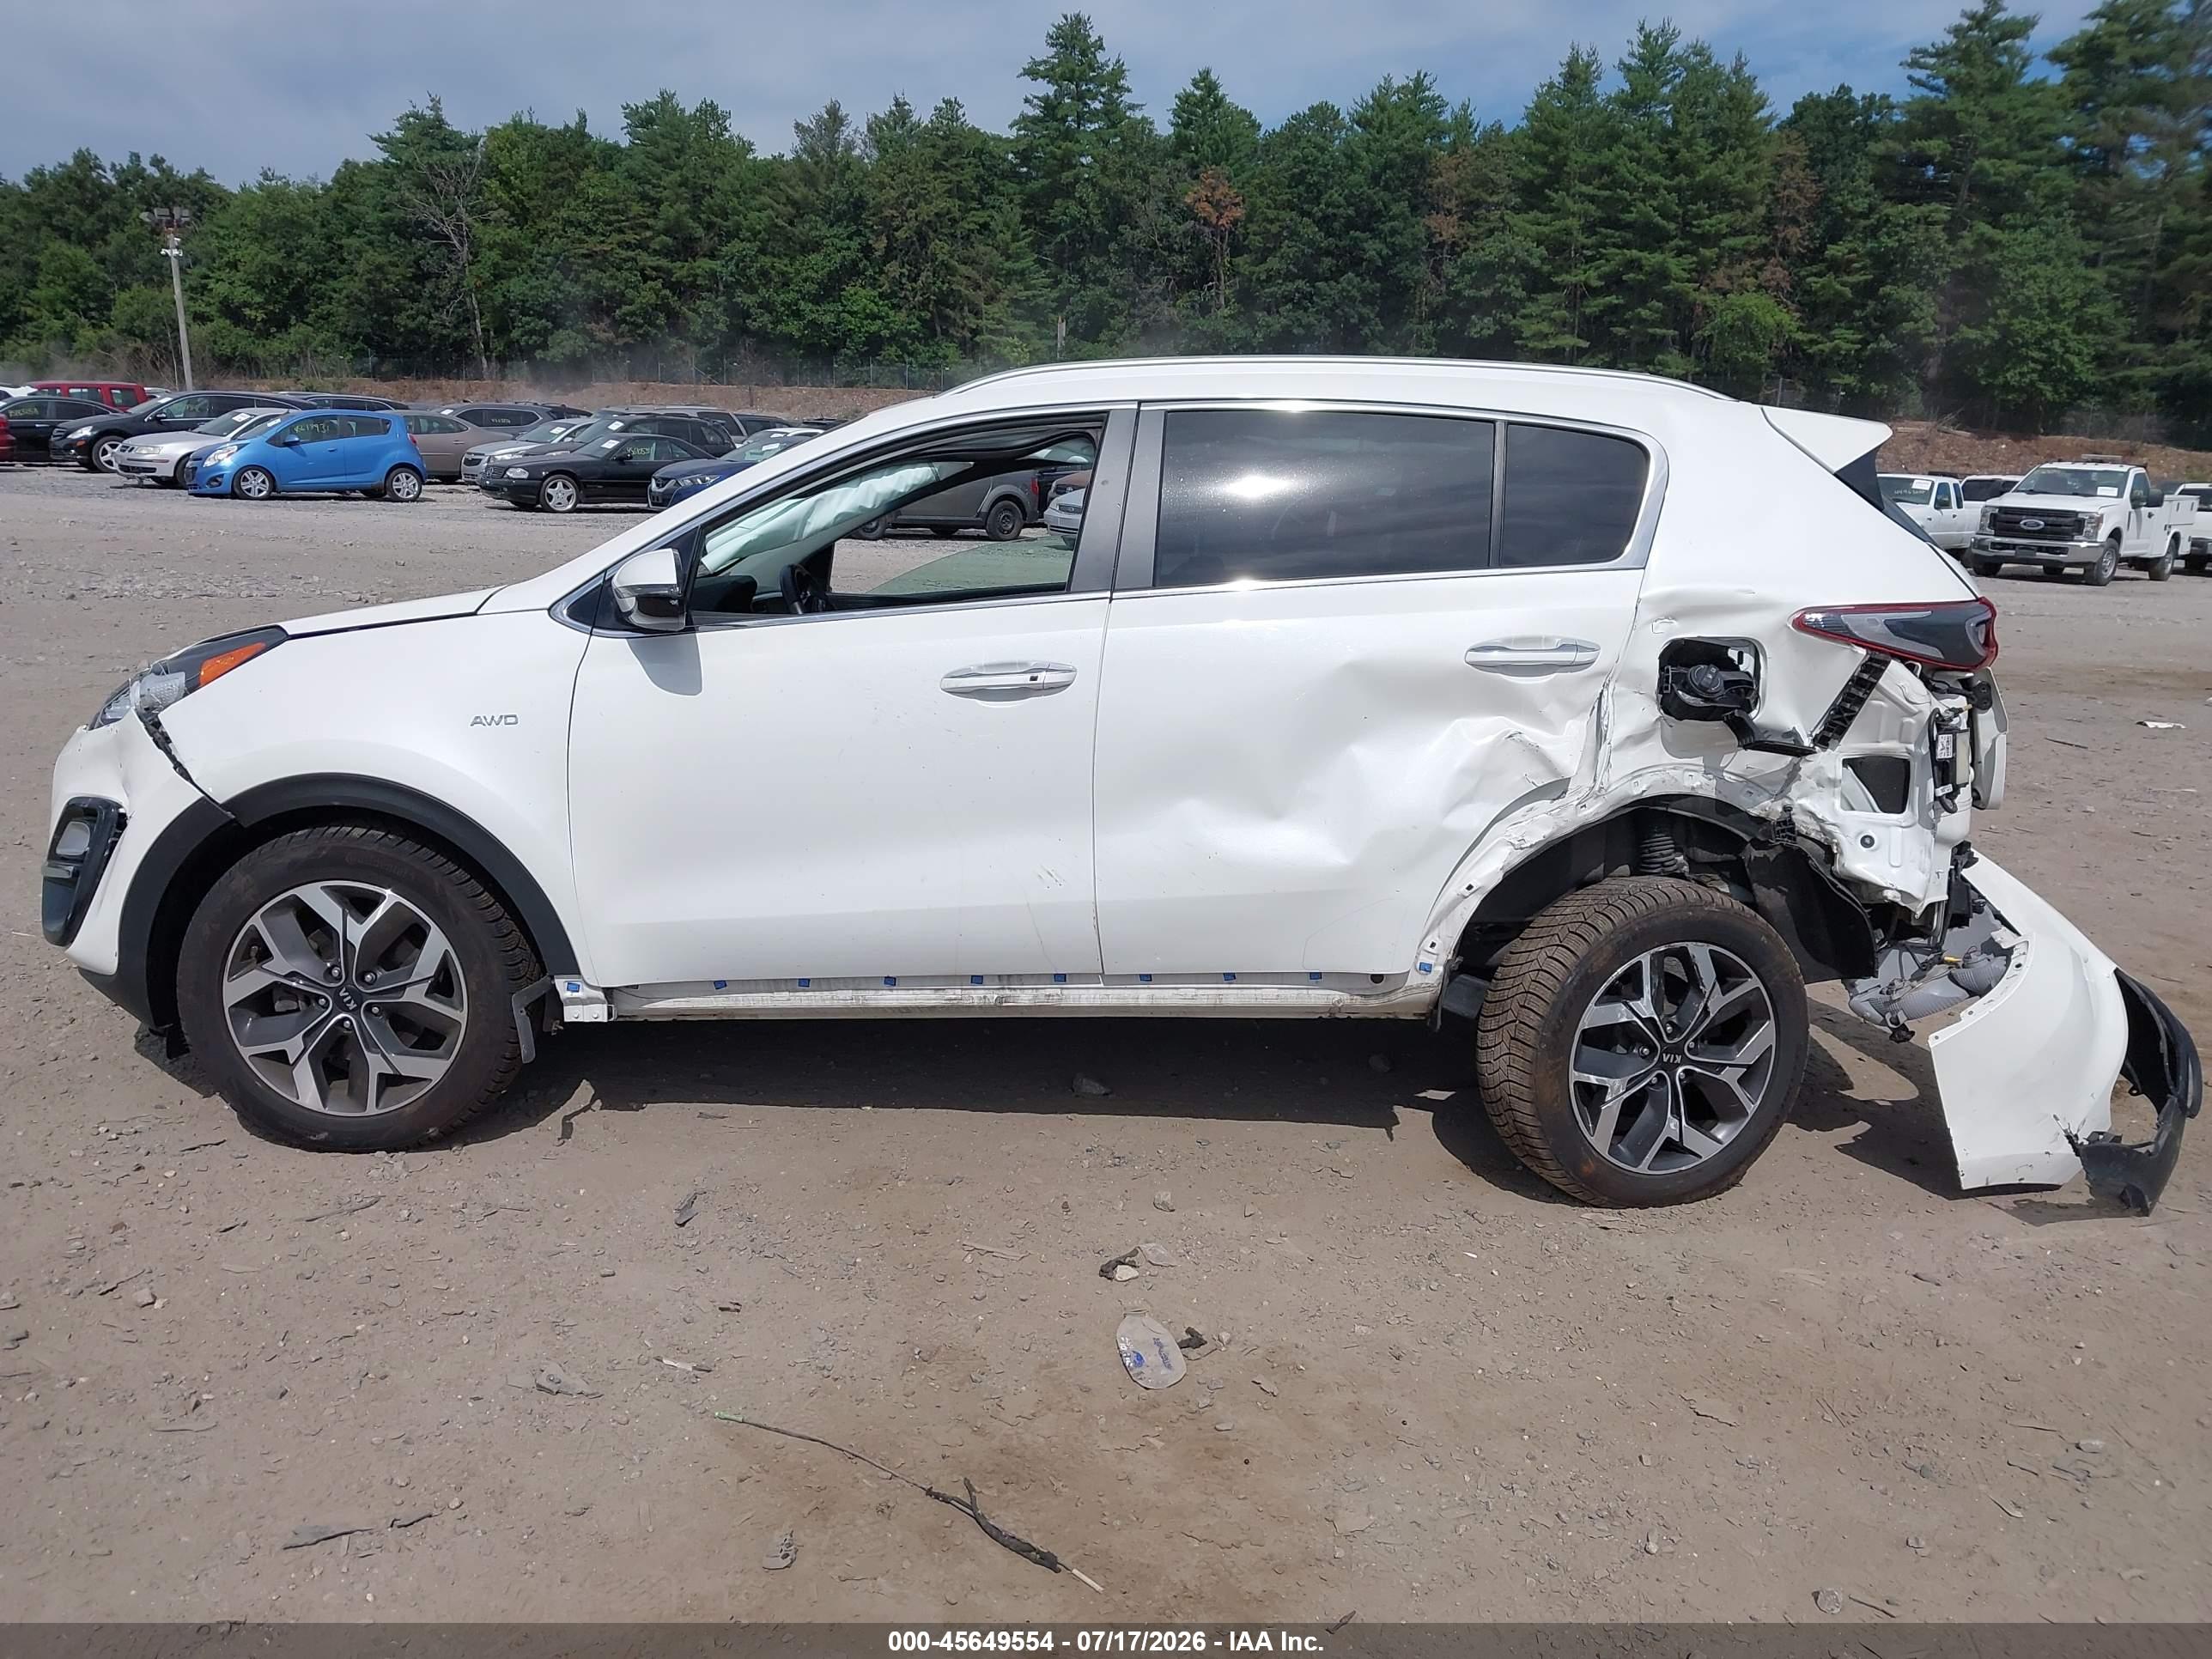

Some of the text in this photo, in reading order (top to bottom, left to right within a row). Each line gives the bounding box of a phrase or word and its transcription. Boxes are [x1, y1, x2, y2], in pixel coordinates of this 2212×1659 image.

[470, 714, 519, 726] AWD
[339, 987, 357, 1011] KIA
[1662, 1053, 1682, 1064] KIA
